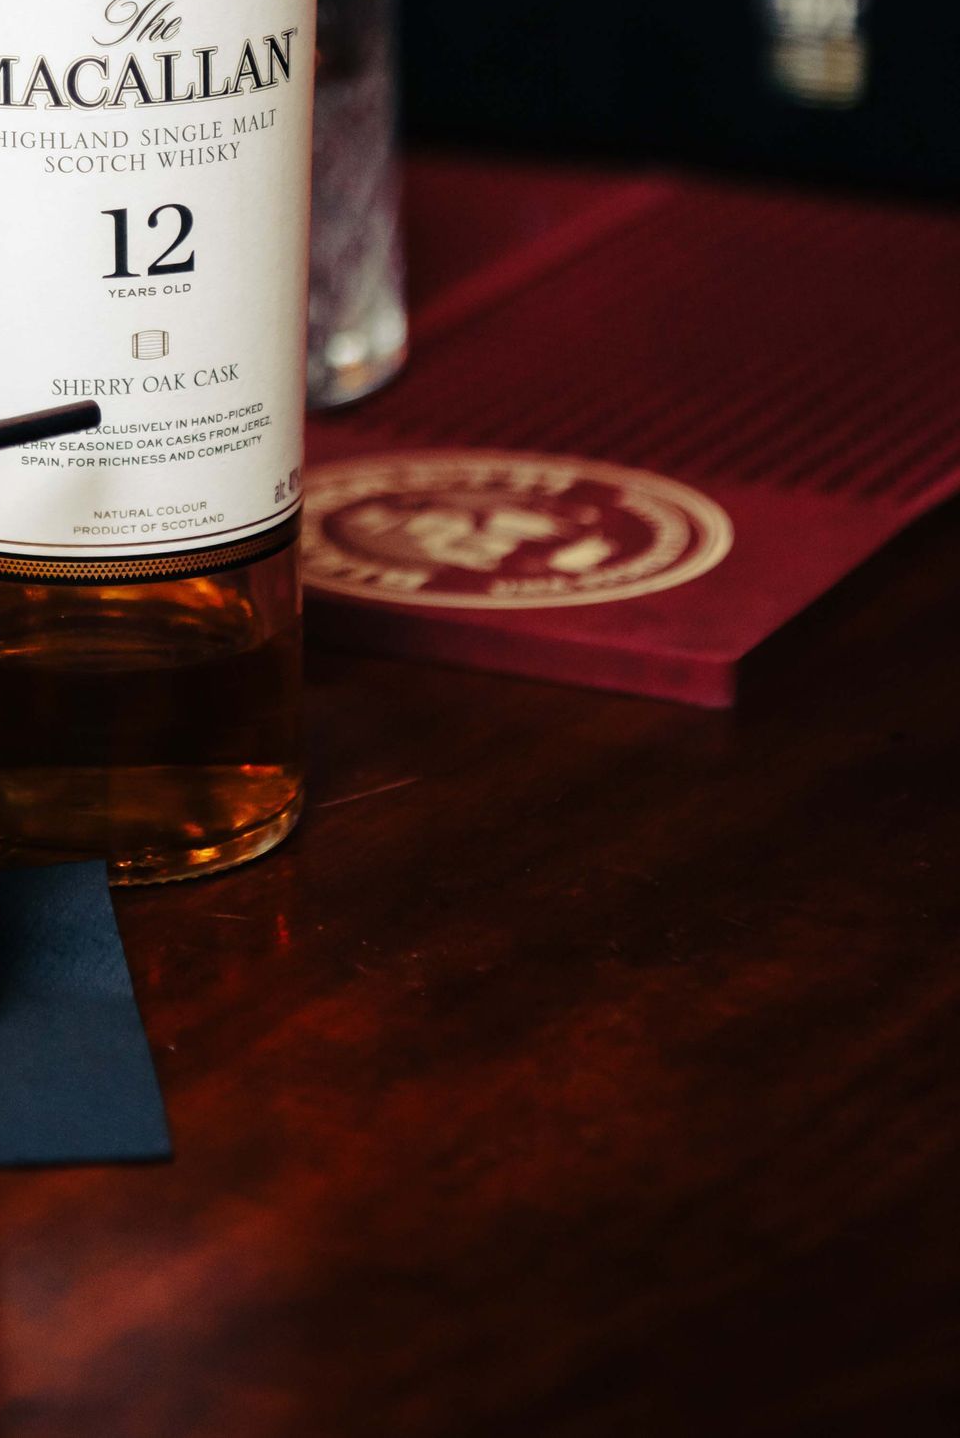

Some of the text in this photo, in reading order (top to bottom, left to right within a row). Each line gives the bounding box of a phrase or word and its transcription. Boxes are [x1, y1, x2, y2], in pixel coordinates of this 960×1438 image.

[141, 121, 222, 147] SINGLE
[233, 109, 277, 135] MALT
[44, 142, 241, 174] SCOTCH WHISKY
[101, 203, 195, 279] 12
[108, 283, 192, 298] YEARS OLD
[52, 363, 240, 396] SHERRY OAK CASK
[175, 420, 188, 429] IN
[191, 402, 264, 427] HAND-PICKED
[17, 441, 56, 450] ERRY
[59, 441, 133, 451] SEASONED
[137, 438, 163, 449] OAK
[166, 432, 207, 446] CASKS
[209, 426, 240, 440] FROM
[21, 434, 263, 468] SPAIN, FOR RICHNESS AND COMPLEXITY
[73, 513, 225, 535] PRODUCT OF SCOTLAND
[94, 501, 208, 519] NATURAL COLOUR
